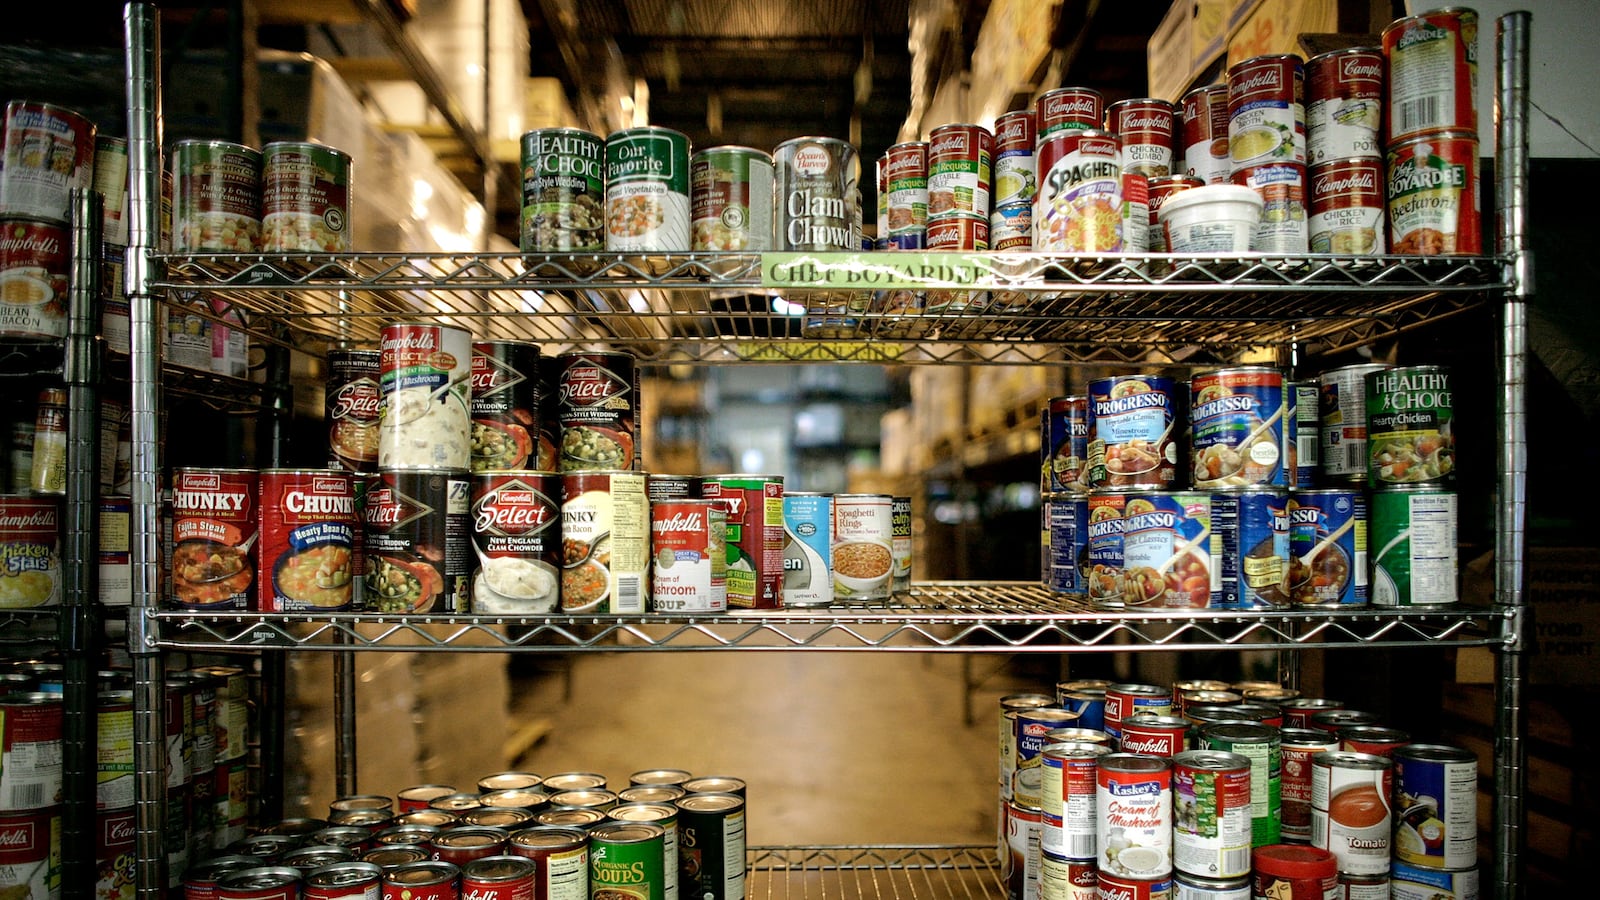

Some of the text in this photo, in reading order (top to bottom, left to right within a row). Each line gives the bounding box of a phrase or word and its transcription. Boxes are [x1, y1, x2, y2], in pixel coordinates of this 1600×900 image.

[1048, 97, 1094, 115] Campbell's
[1124, 113, 1171, 130] Campbell's
[529, 135, 600, 160] HEALTHY
[618, 145, 647, 160] Our
[1129, 146, 1165, 155] CHICKEN
[1353, 142, 1378, 151] POT
[1132, 153, 1162, 161] GUMBO
[608, 157, 664, 178] Favorite
[554, 177, 586, 192] Wedding
[623, 185, 665, 196] Vegetables
[1315, 173, 1374, 195] Campbell's
[1388, 167, 1463, 199] BOYARDEE
[787, 189, 845, 219] Clam
[1391, 194, 1457, 222] Beefaroni
[1323, 209, 1366, 222] CHICKEN
[1339, 217, 1362, 226] RICE
[770, 263, 988, 284] CHEF BOYARDEE
[383, 352, 424, 362] SELECT
[1375, 374, 1449, 394] HEALTHY
[1096, 392, 1165, 415] PROGRESSO
[1390, 392, 1453, 410] CHOICE
[1396, 413, 1432, 424] Chicken
[172, 488, 245, 511] CHUNKY
[475, 492, 545, 533] Select
[838, 507, 875, 519] Spaghetti
[177, 521, 227, 534] Fajita Steak
[294, 523, 340, 540] Hearty Bean
[572, 525, 593, 534] Bacon
[839, 519, 863, 529] Rings
[487, 543, 543, 552] CLAM CHOWDER
[490, 536, 507, 544] NEW
[9, 556, 50, 571] Stars
[653, 584, 696, 596] ushroom
[653, 599, 687, 610] SOUP
[1121, 734, 1169, 754] Campbell's
[1113, 782, 1159, 796] Kaskey's
[1107, 801, 1146, 815] Cream
[1147, 801, 1161, 819] of
[1106, 813, 1162, 827] Mushroom
[1347, 836, 1387, 848] Tomato
[592, 861, 645, 883] SOUPS
